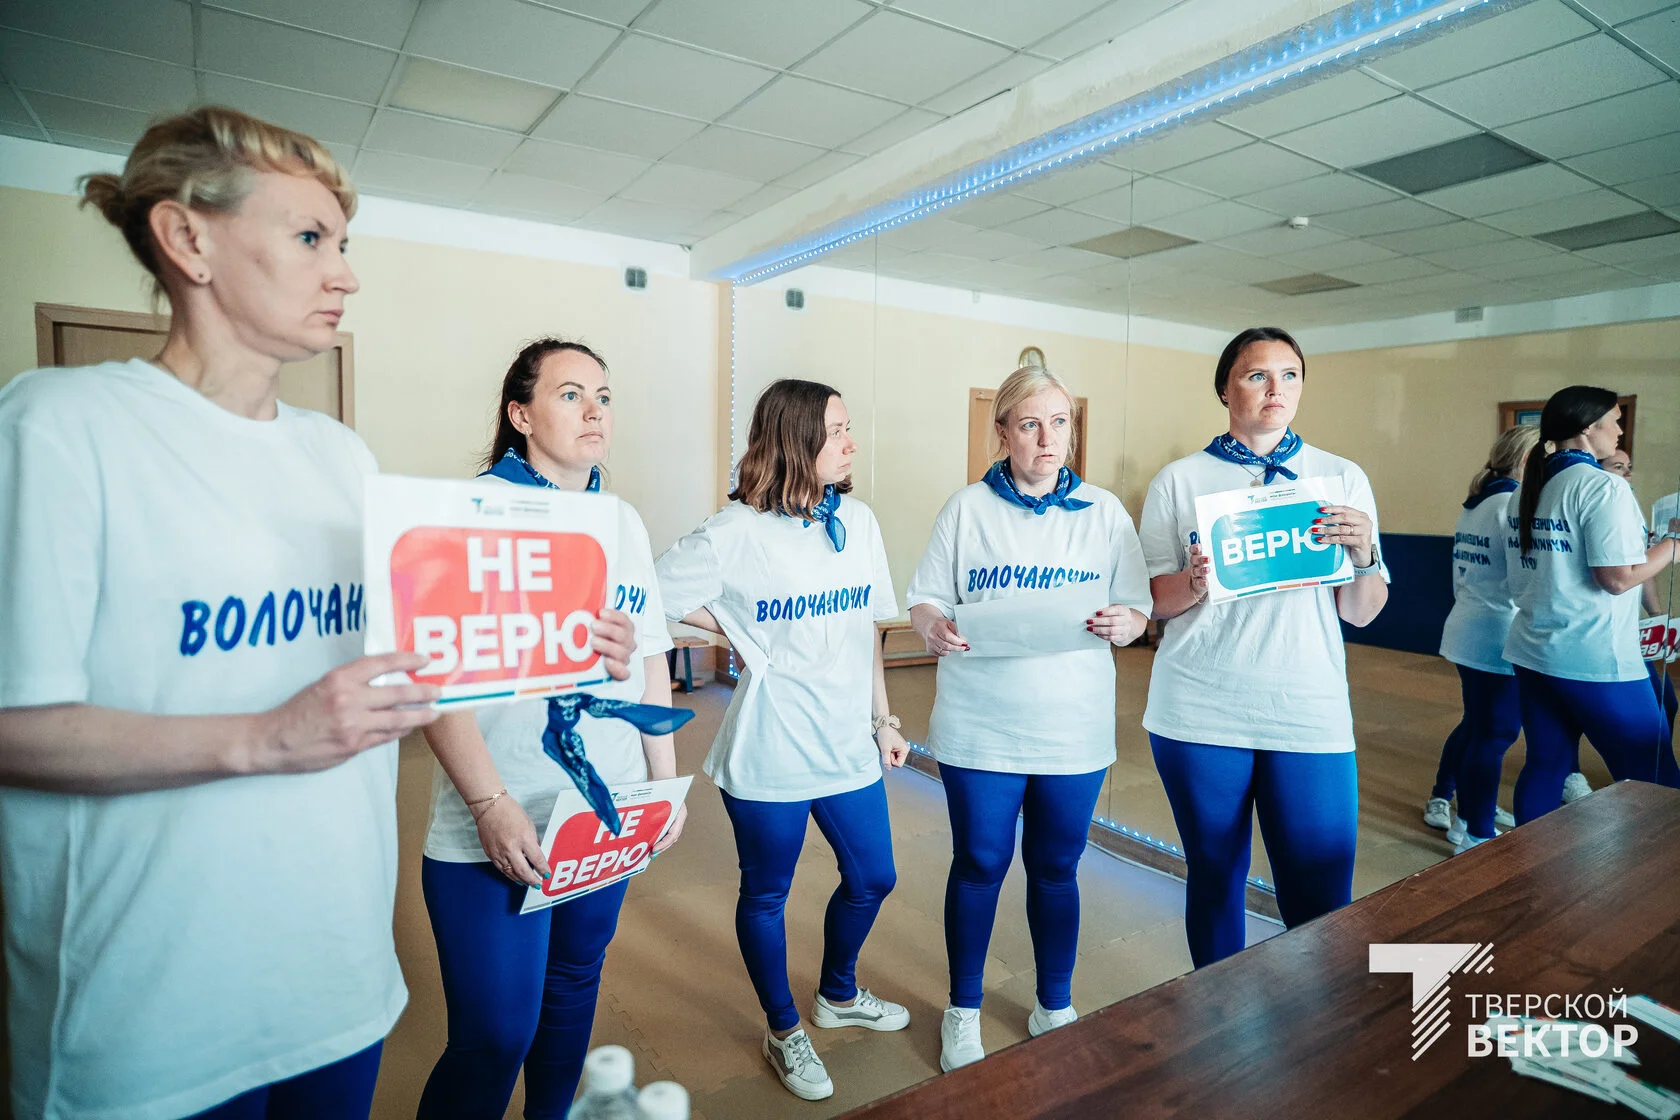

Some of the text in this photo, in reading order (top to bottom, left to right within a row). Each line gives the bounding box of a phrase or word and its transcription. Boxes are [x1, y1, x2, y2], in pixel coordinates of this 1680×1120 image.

[466, 536, 553, 592] НЕ
[1221, 524, 1332, 566] ВЕРЮ
[179, 582, 366, 658] ВОЛОЧАН
[413, 609, 597, 677] ВЕРЮ
[548, 841, 649, 891] ВЕРЮ
